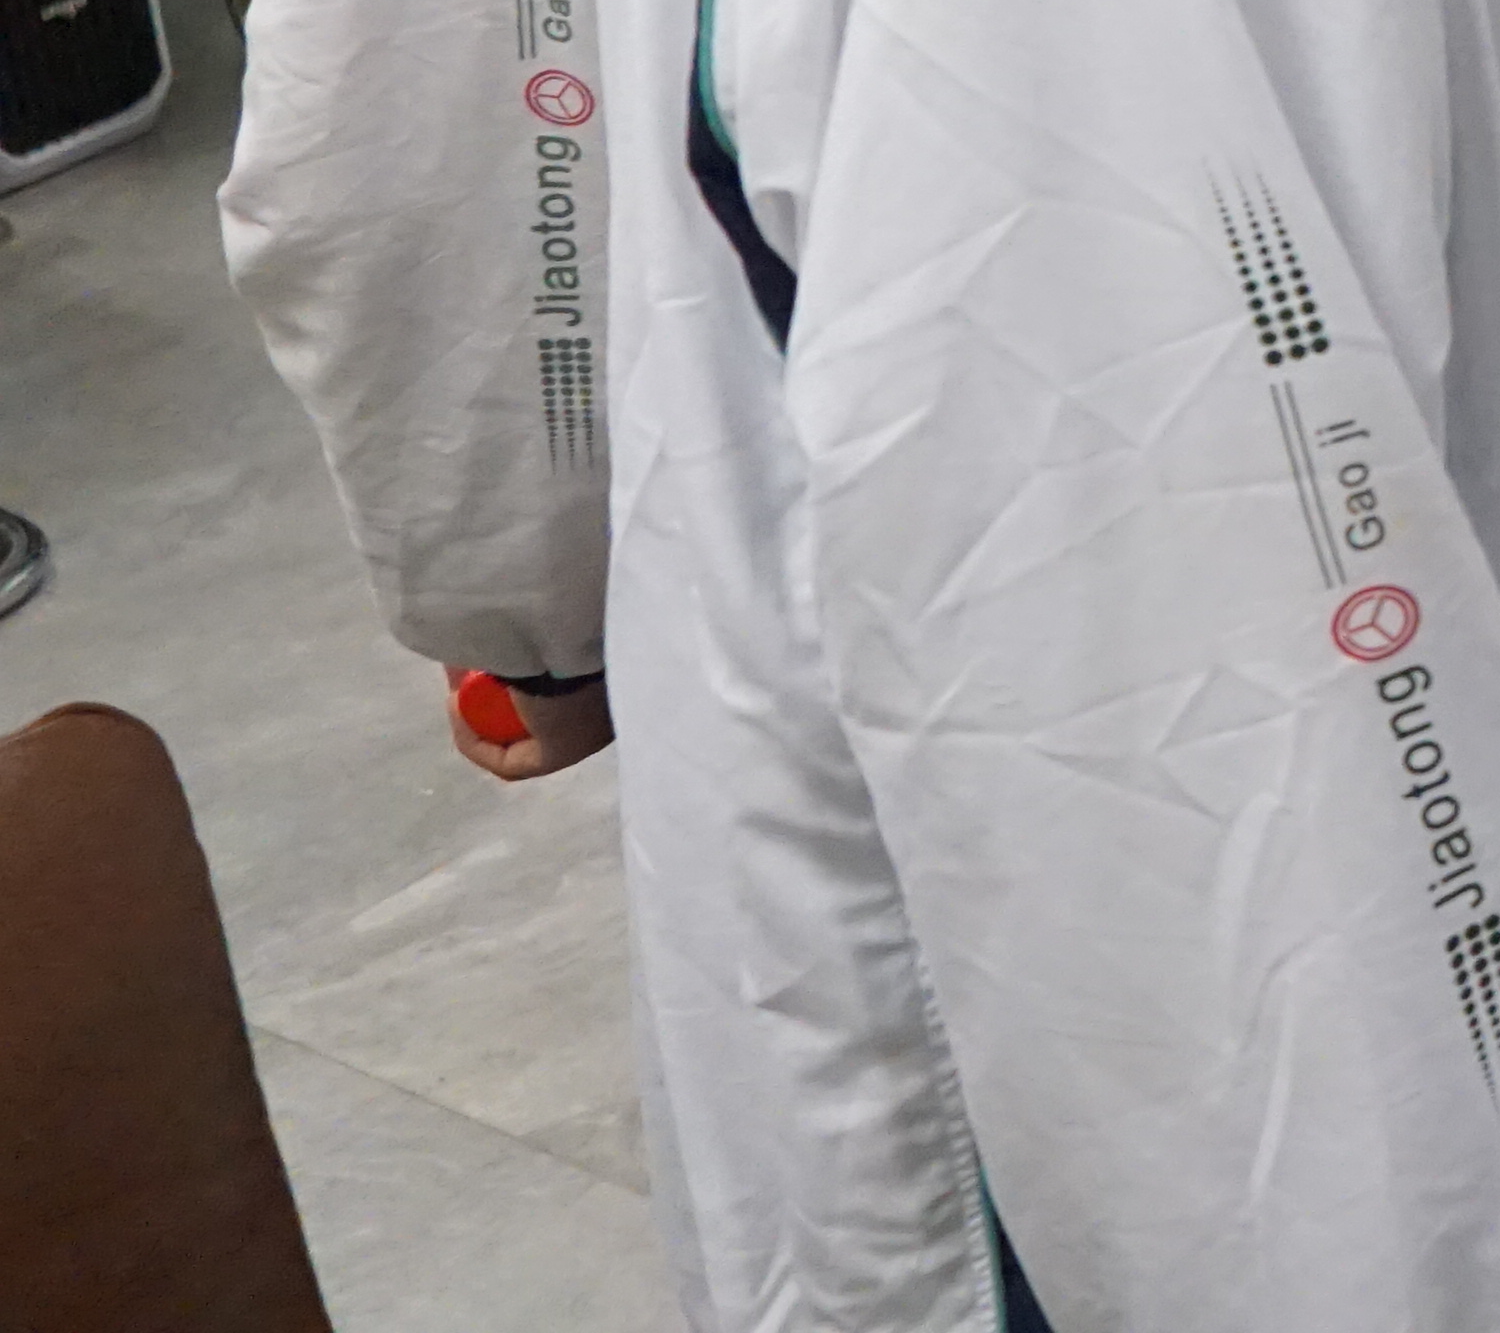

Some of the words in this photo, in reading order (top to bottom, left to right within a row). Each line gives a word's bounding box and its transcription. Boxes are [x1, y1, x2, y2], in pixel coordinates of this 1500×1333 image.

[531, 135, 584, 328] Jiaotong
[1338, 461, 1387, 552] Gao
[1375, 664, 1485, 910] Jiaotong
